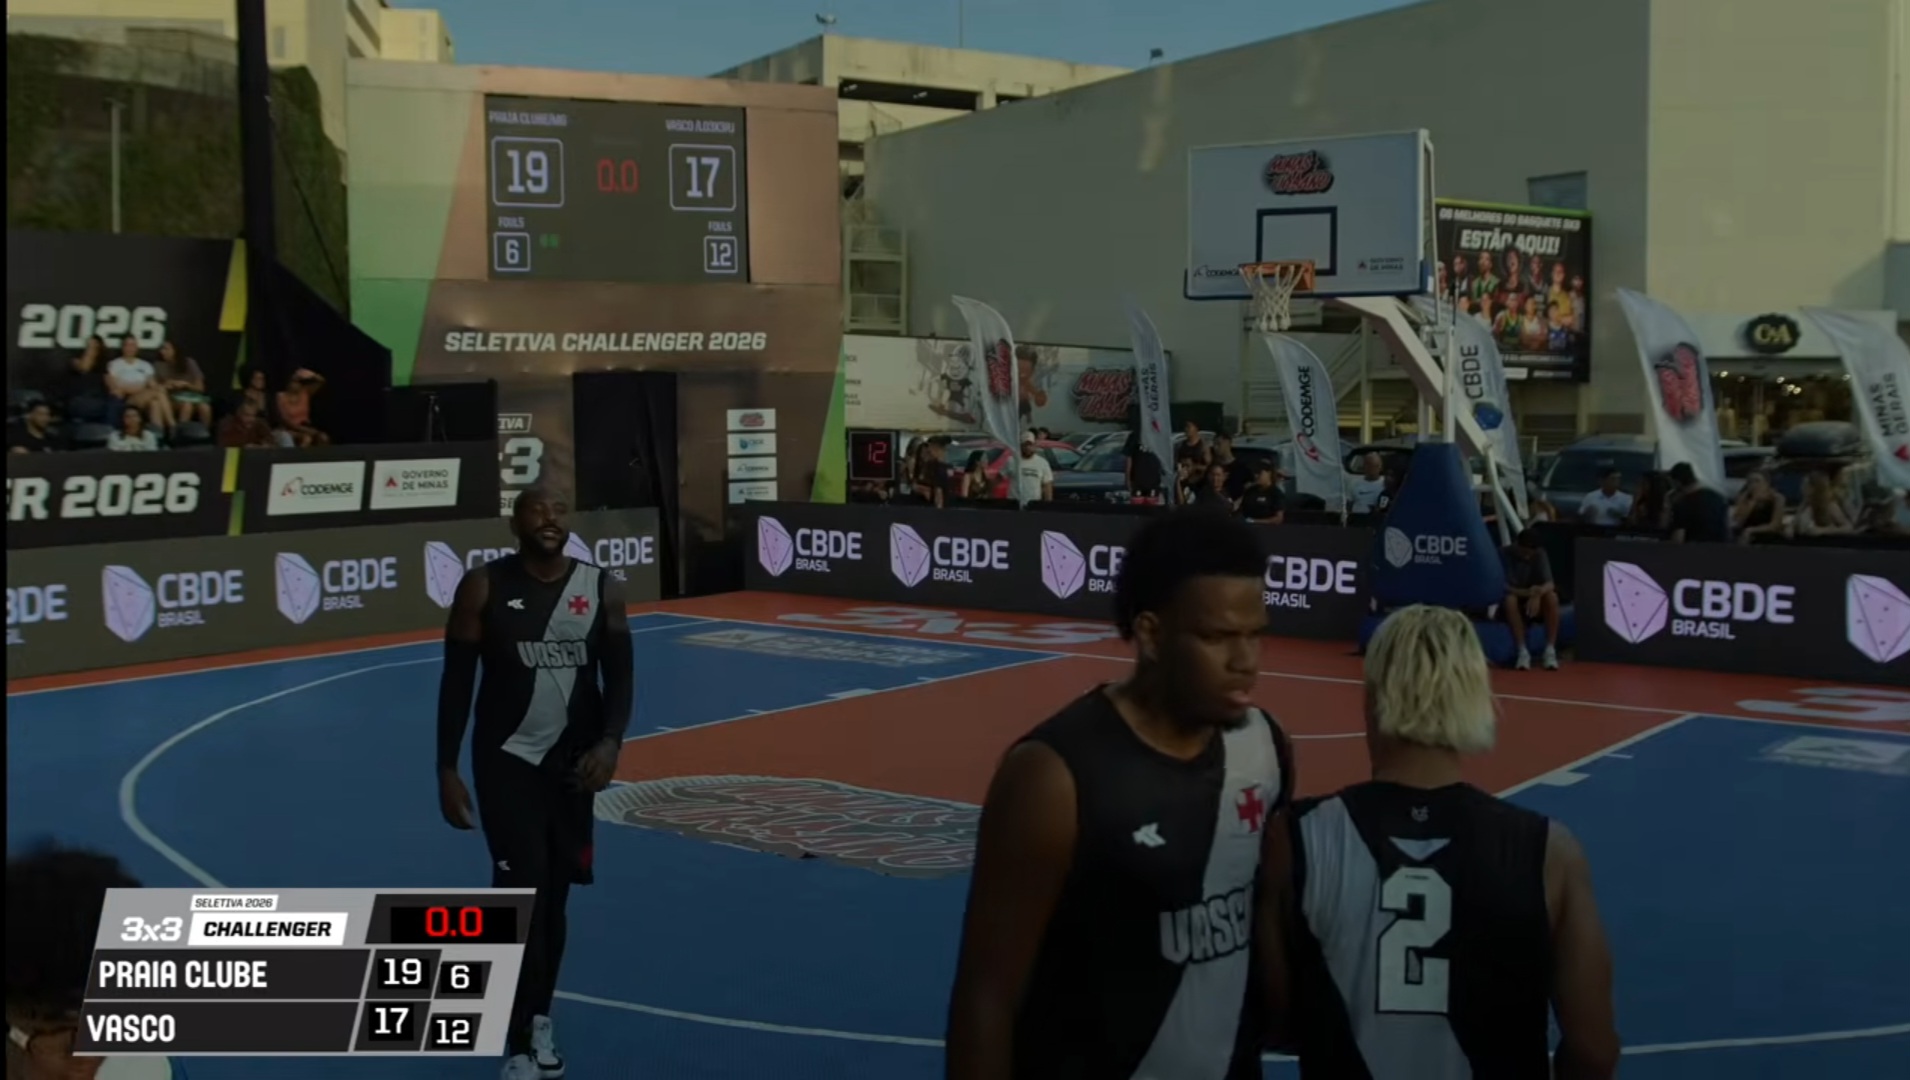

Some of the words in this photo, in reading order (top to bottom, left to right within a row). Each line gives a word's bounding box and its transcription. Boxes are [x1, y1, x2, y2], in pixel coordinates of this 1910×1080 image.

[507, 150, 548, 193] 19
[598, 158, 639, 193] 0.0
[686, 156, 720, 198] 17
[498, 217, 525, 228] FOULS
[708, 221, 732, 232] FOULS
[505, 239, 519, 264] 6
[710, 242, 732, 266] 12
[1460, 228, 1513, 250] ESTÃO
[1515, 233, 1561, 256] AQUI!
[17, 303, 168, 349] 2026
[444, 332, 556, 351] SELETIVA
[562, 332, 703, 351] CHALLENGER
[708, 332, 766, 350] 2026
[1460, 345, 1484, 399] CBDE
[1298, 365, 1315, 437] CODEMGE
[1869, 384, 1894, 437] MINAS
[868, 441, 888, 464] 12
[402, 469, 449, 479] GOVERNO
[402, 481, 415, 490] DE
[418, 480, 449, 490] MINAS
[60, 472, 200, 518] 2026
[301, 482, 354, 496] CODEMGE
[594, 536, 654, 567] CBDE
[796, 527, 863, 560] CBDE
[933, 536, 1010, 570] CBDE
[1415, 534, 1468, 556] CBDE
[796, 558, 831, 572] BRASIL
[1089, 545, 1127, 577] CB
[1264, 554, 1358, 594] CBDE
[1414, 554, 1443, 566] BRASIL
[157, 569, 244, 608] CBDE
[323, 557, 397, 593] CBDE
[933, 568, 973, 583] BRASIL
[323, 595, 364, 611] BRASIL
[1263, 591, 1312, 609] BRASIL
[1672, 578, 1796, 624] CBDE
[158, 610, 206, 628] BRASIL
[1671, 619, 1736, 640] BRASIL
[516, 641, 589, 668] VASCO
[1159, 880, 1256, 965] VASC
[1376, 866, 1453, 1014] 2
